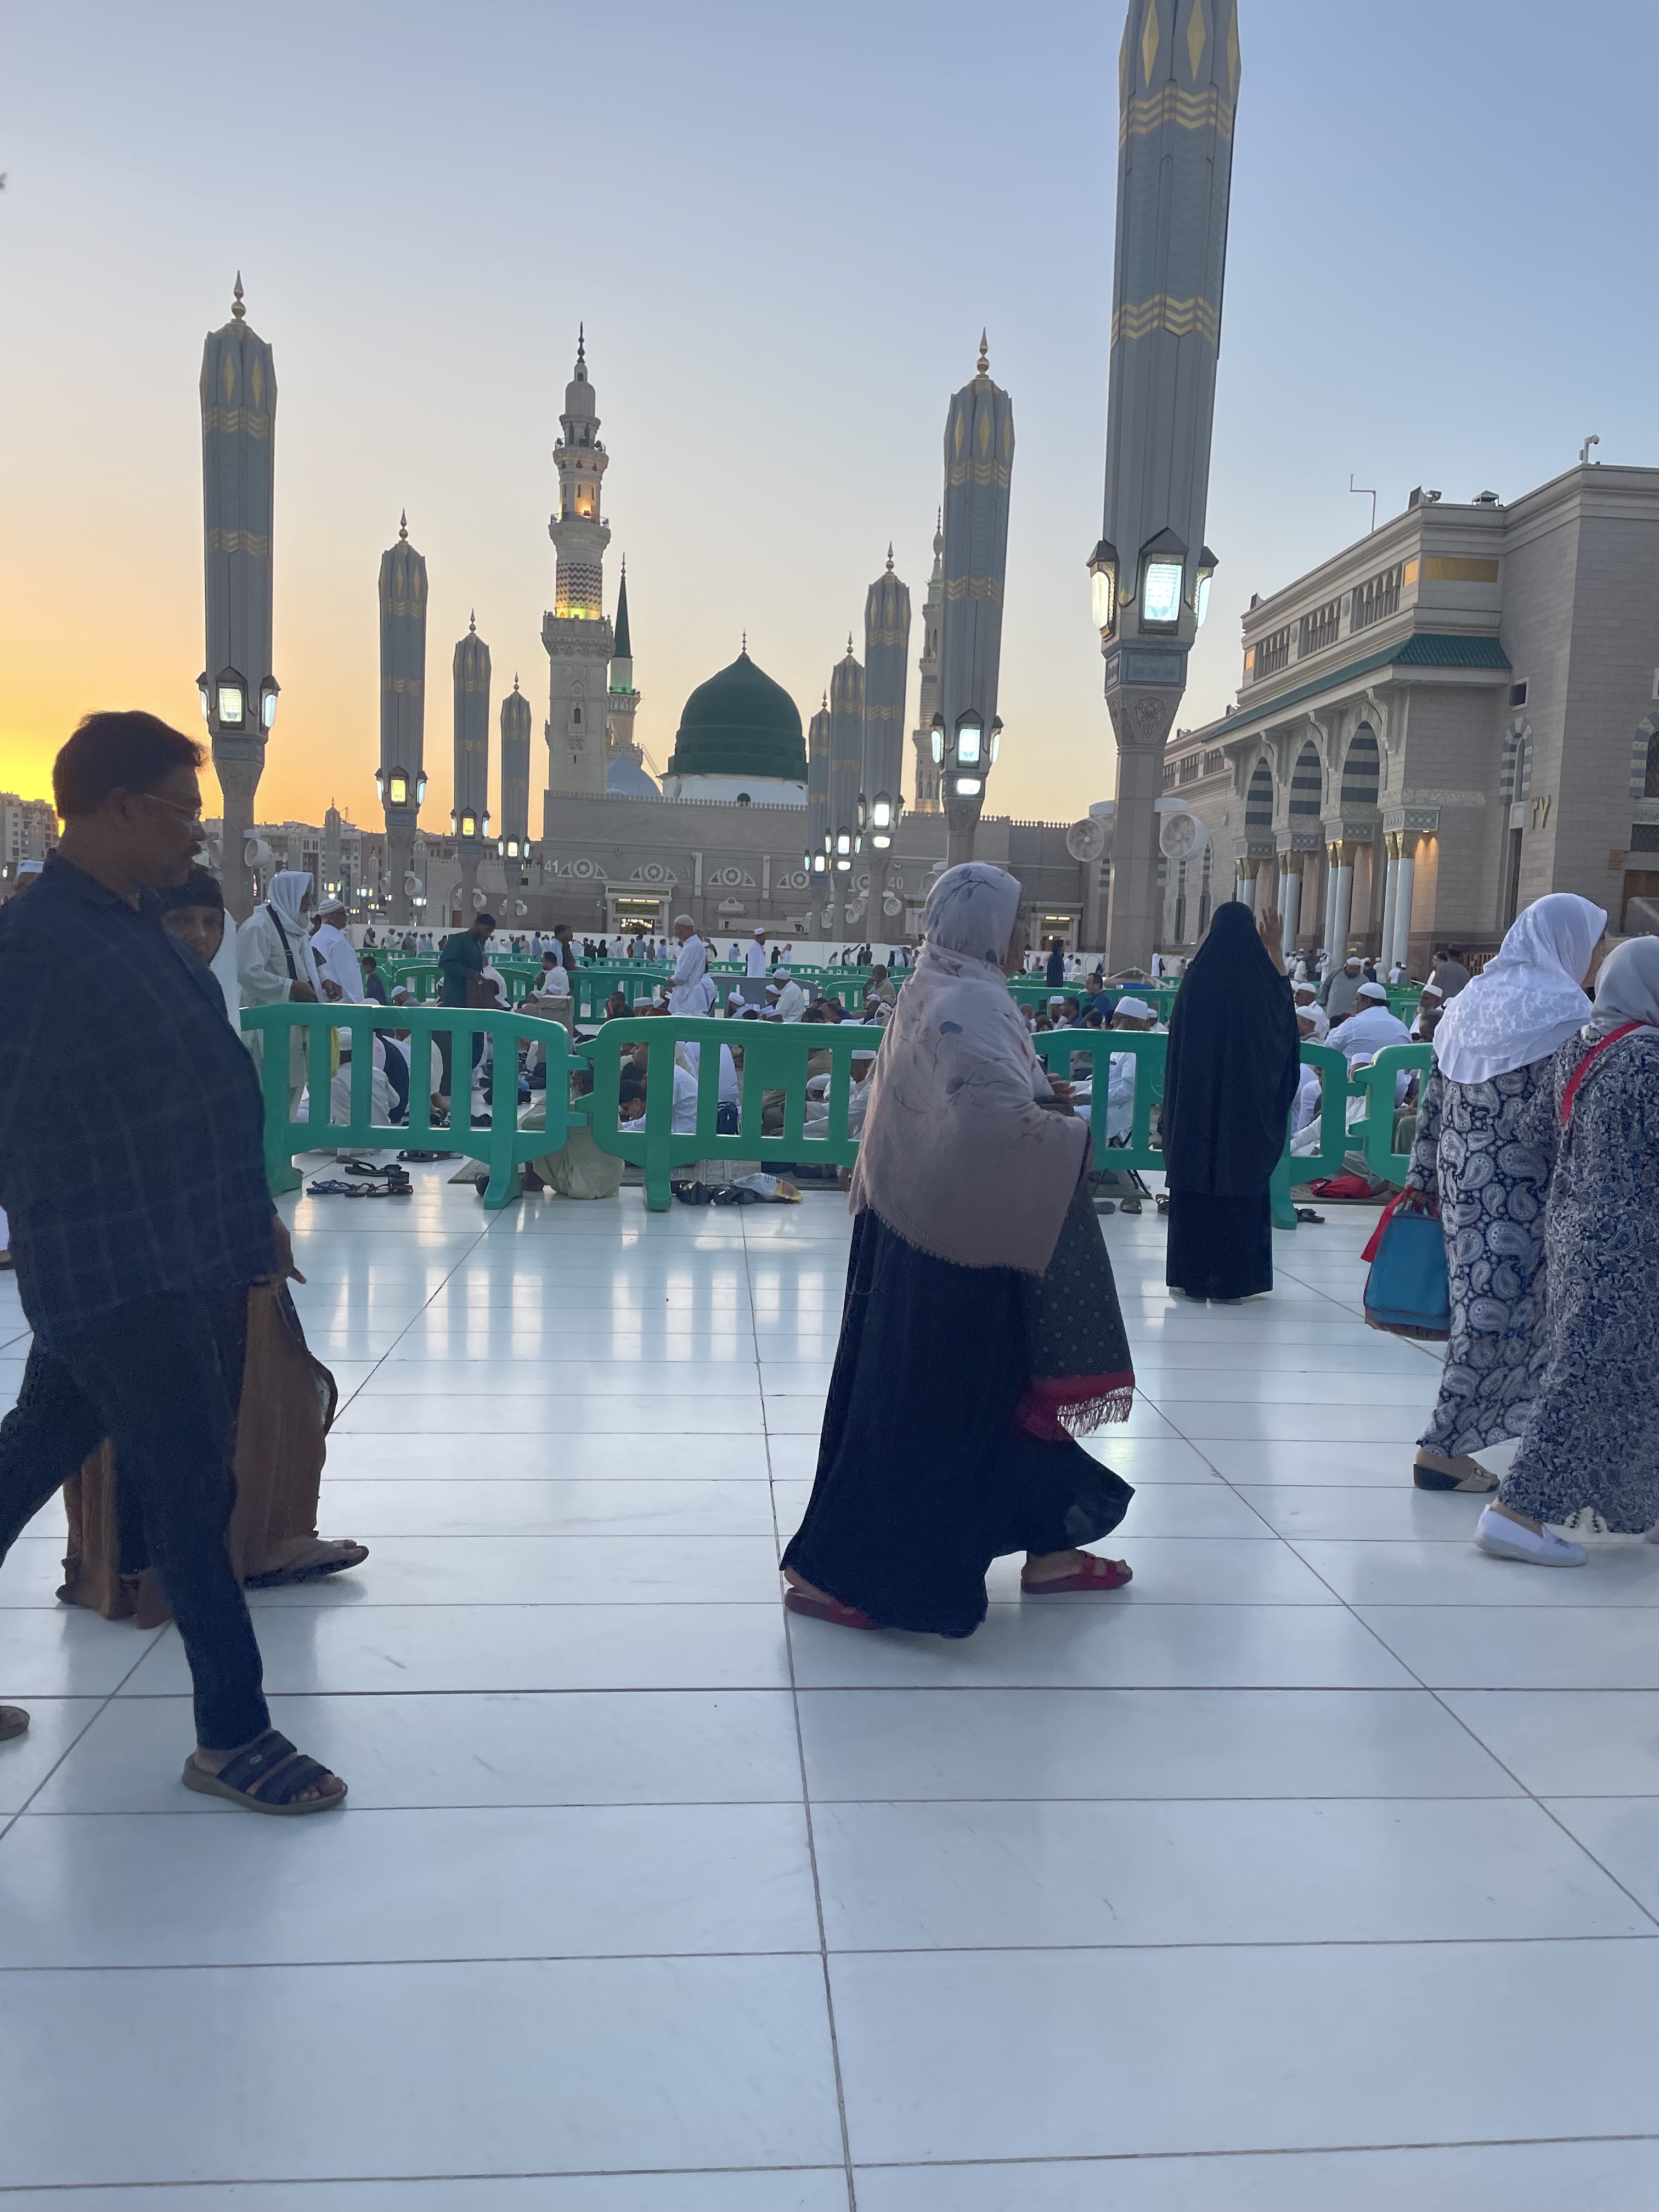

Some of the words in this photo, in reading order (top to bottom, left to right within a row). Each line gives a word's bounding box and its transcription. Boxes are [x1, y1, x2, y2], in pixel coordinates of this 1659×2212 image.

[1531, 794, 1551, 830] ٣٧
[544, 860, 558, 873] 41
[888, 877, 904, 889] 40
